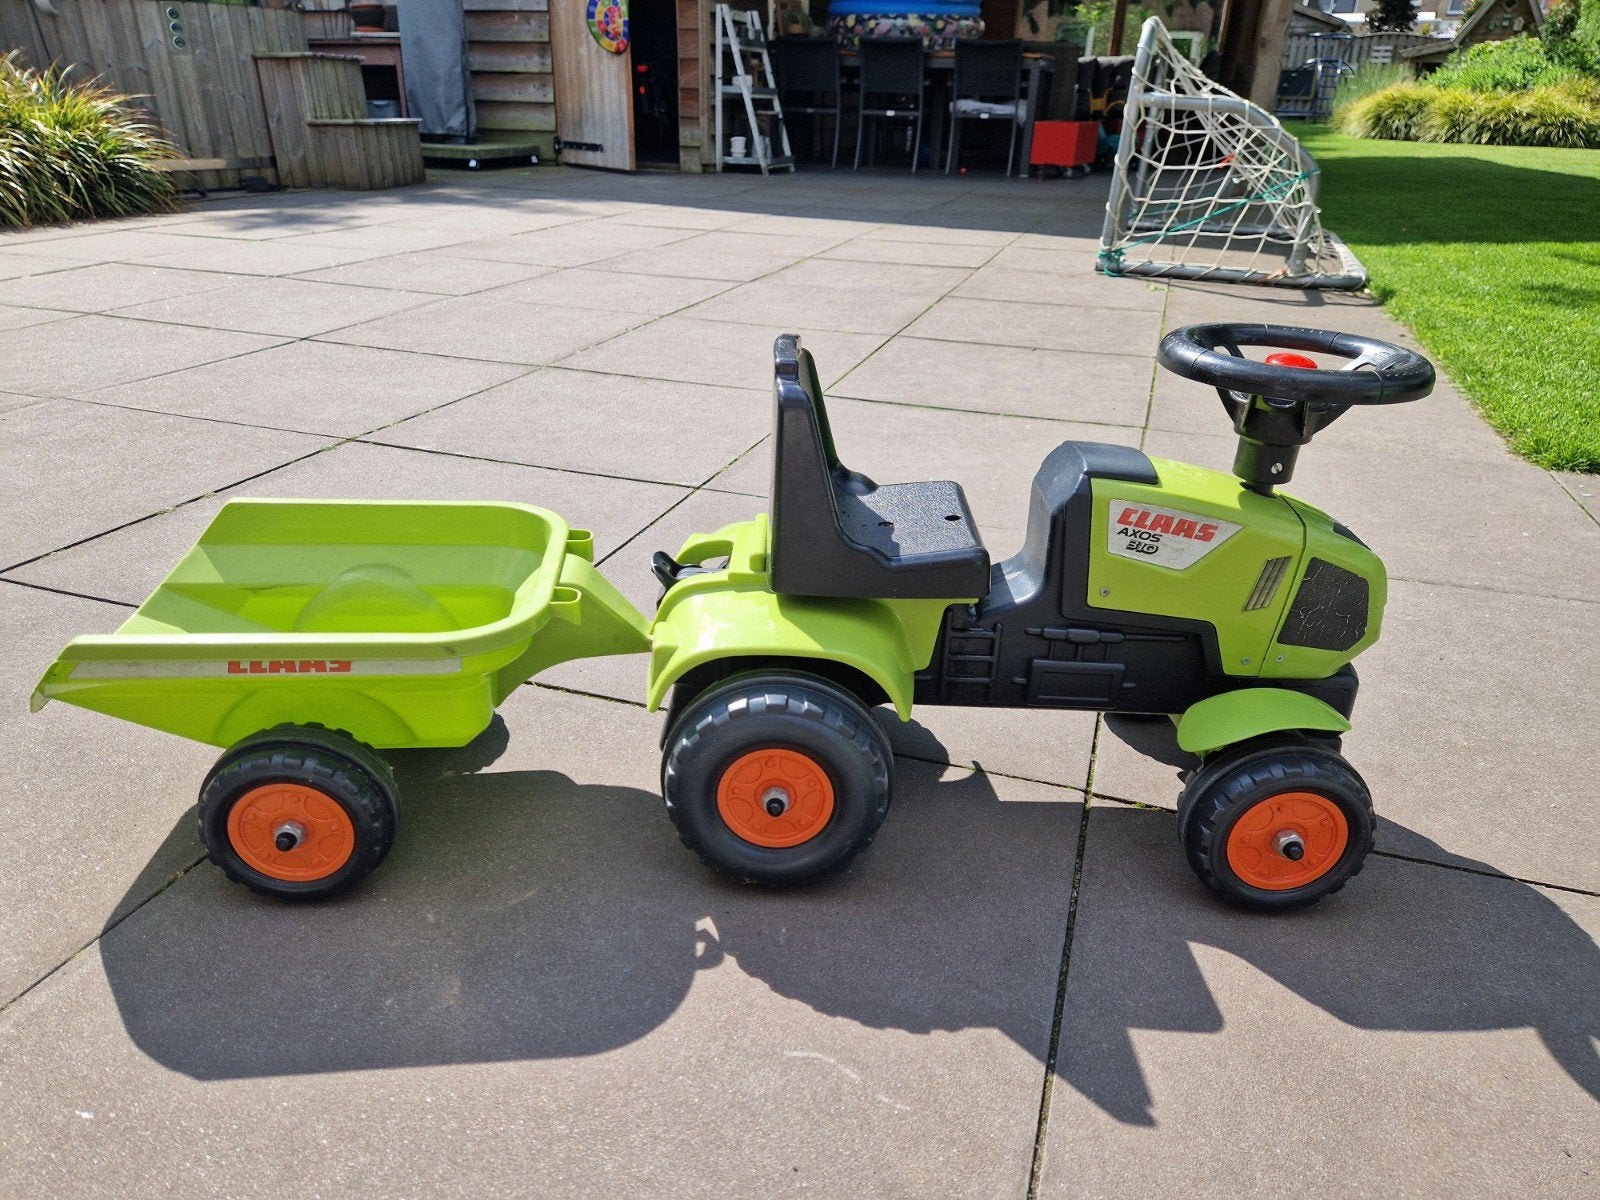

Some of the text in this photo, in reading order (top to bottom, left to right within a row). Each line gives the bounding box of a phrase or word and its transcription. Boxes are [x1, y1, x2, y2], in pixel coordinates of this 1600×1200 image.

[1117, 507, 1219, 542] CLAAS
[1117, 527, 1162, 543] AXOS
[1125, 540, 1159, 554] 310
